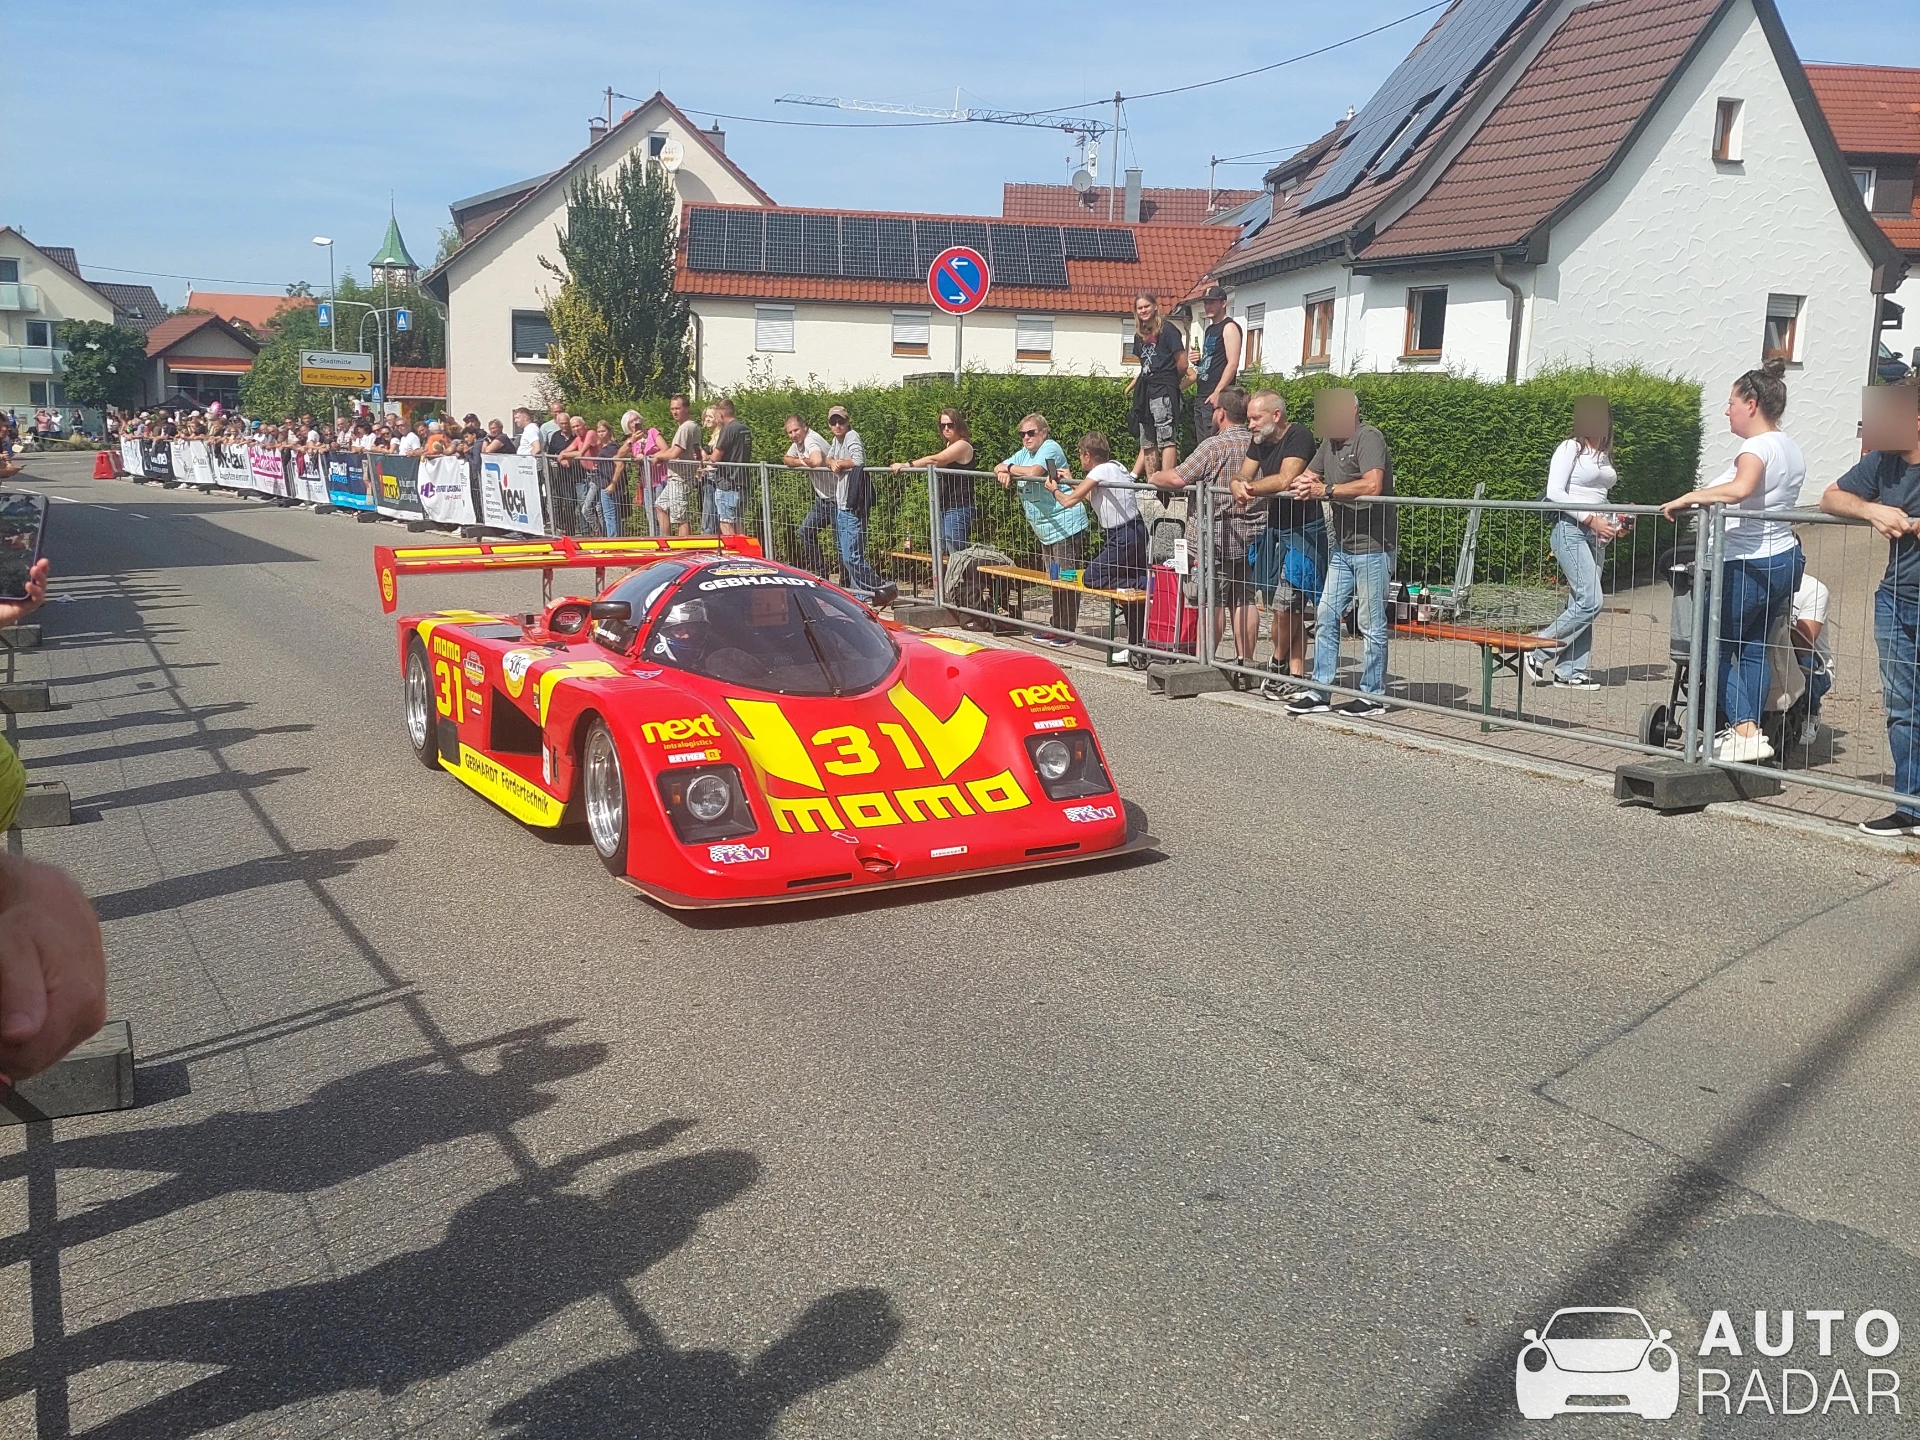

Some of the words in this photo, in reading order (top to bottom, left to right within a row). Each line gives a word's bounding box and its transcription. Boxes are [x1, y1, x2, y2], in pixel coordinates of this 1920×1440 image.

[319, 357, 352, 365] Stadtmitte
[320, 373, 355, 382] Richtungen
[500, 484, 528, 517] KOCH
[698, 576, 818, 591] GEBHARDT
[433, 635, 461, 663] momo
[435, 659, 464, 724] 31
[1008, 679, 1076, 708] next
[1030, 703, 1071, 713] intralogistics
[640, 713, 722, 744] next
[663, 738, 713, 750] intralogistics
[811, 722, 926, 777] 31
[465, 752, 499, 785] GEBHARDT
[501, 770, 549, 816] Fördertechnik
[764, 767, 1032, 834] momo
[1077, 805, 1116, 822] KW
[722, 846, 770, 864] KW
